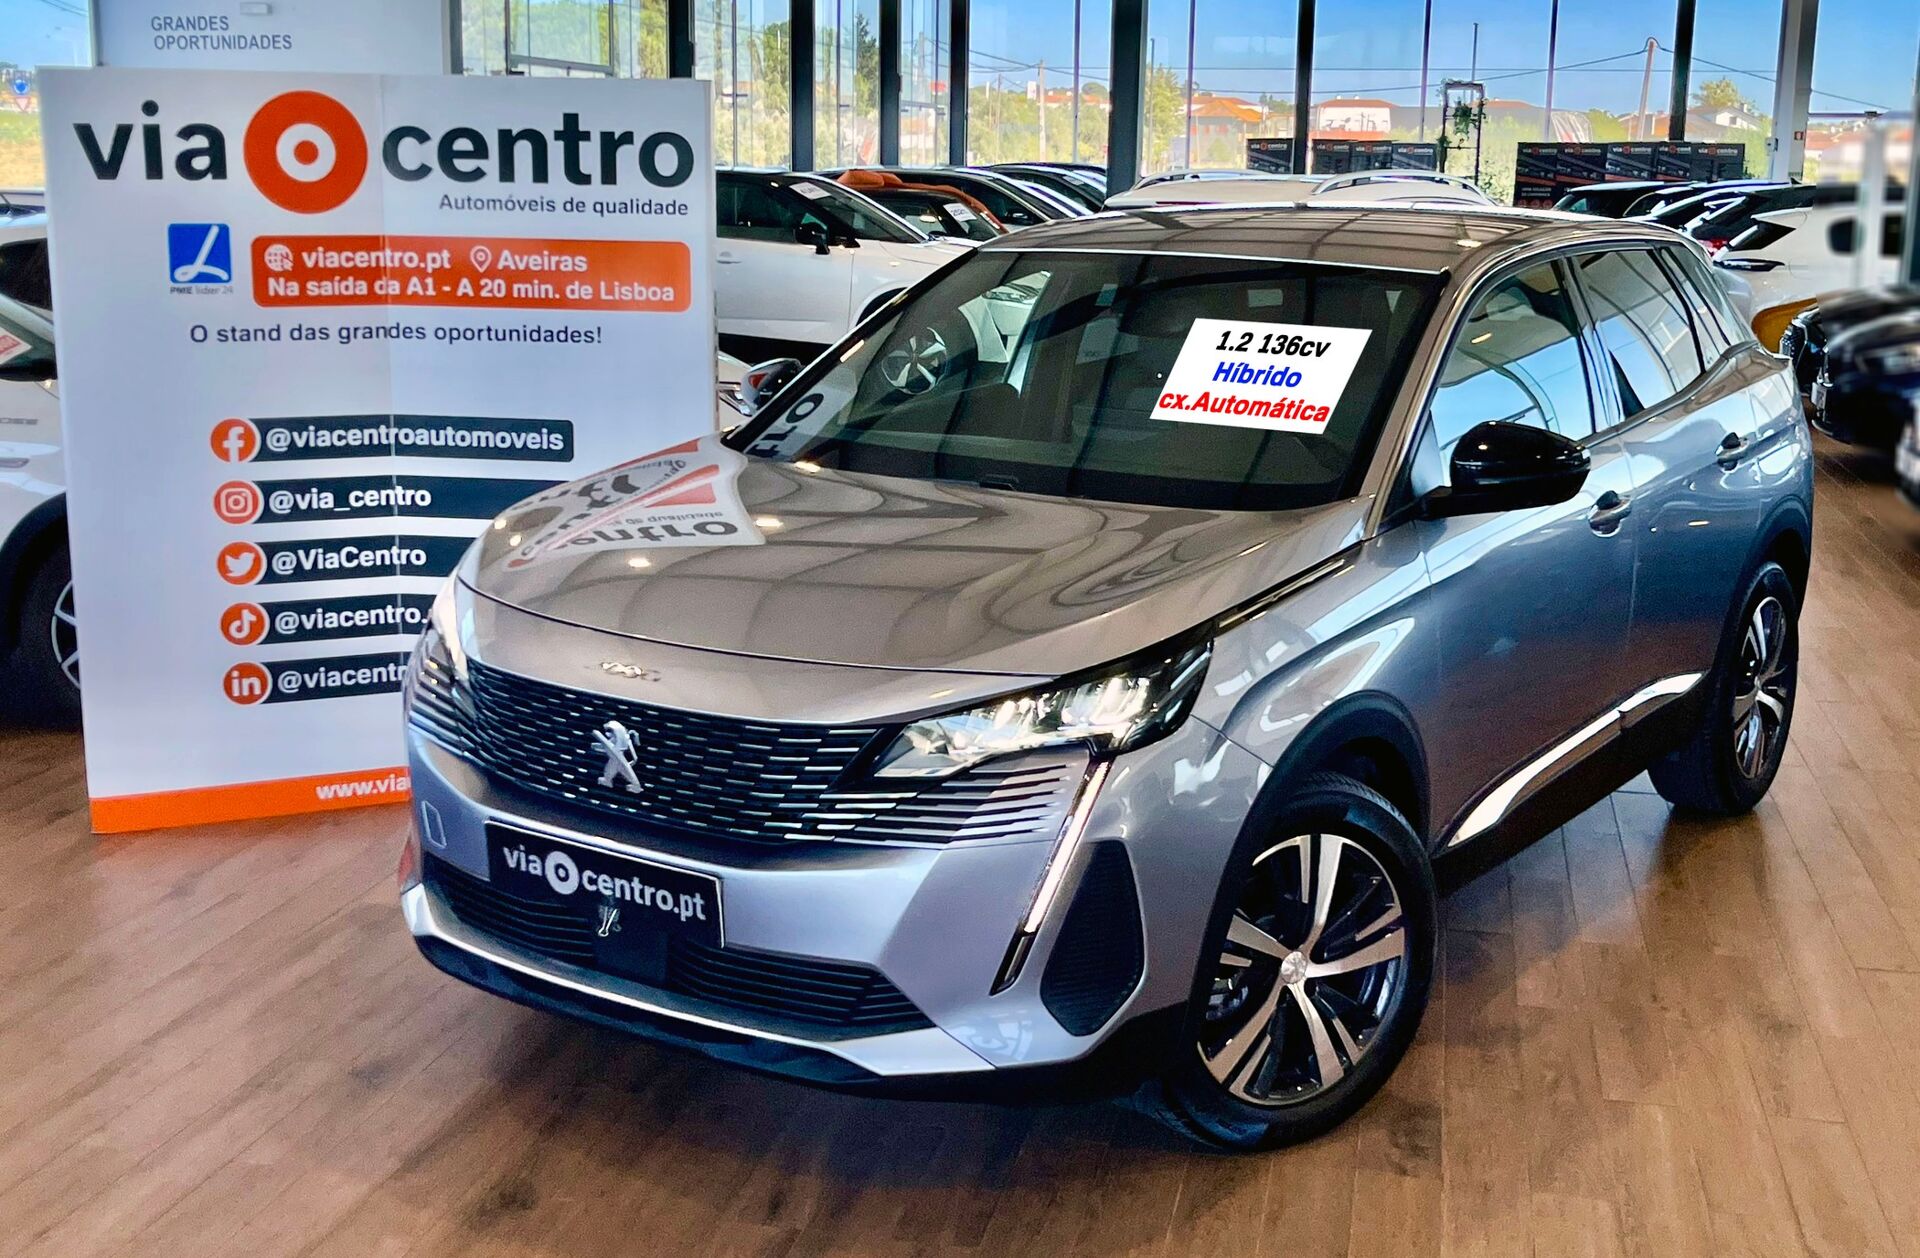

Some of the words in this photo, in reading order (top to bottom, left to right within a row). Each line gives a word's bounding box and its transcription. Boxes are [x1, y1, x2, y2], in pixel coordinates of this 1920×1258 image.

[151, 15, 229, 31] GRANDES
[154, 34, 292, 50] OPORTUNIDADES
[73, 100, 227, 181] via
[382, 112, 694, 188] centro
[439, 194, 556, 213] Automóveis
[562, 197, 586, 213] de
[592, 198, 689, 217] qualidade
[302, 246, 451, 273] viacentro.pt
[497, 250, 588, 272] Aveiras
[267, 277, 299, 296] Na
[306, 276, 368, 296] saída
[373, 276, 400, 295] da
[406, 276, 436, 296] A1
[456, 277, 475, 297] A
[479, 278, 506, 298] 20
[512, 280, 560, 299] min.
[565, 281, 593, 299] de
[600, 281, 675, 301] Lisboa
[190, 324, 208, 343] O
[216, 324, 281, 342] stand
[289, 323, 330, 341] das
[338, 322, 426, 345] grandes
[434, 324, 602, 345] oportunidades!
[265, 425, 564, 452] @viacentroautomoveis
[269, 486, 432, 514] @via_centro
[271, 545, 427, 575] @ViaCentro
[503, 844, 543, 877] via
[581, 869, 706, 922] centro.pt
